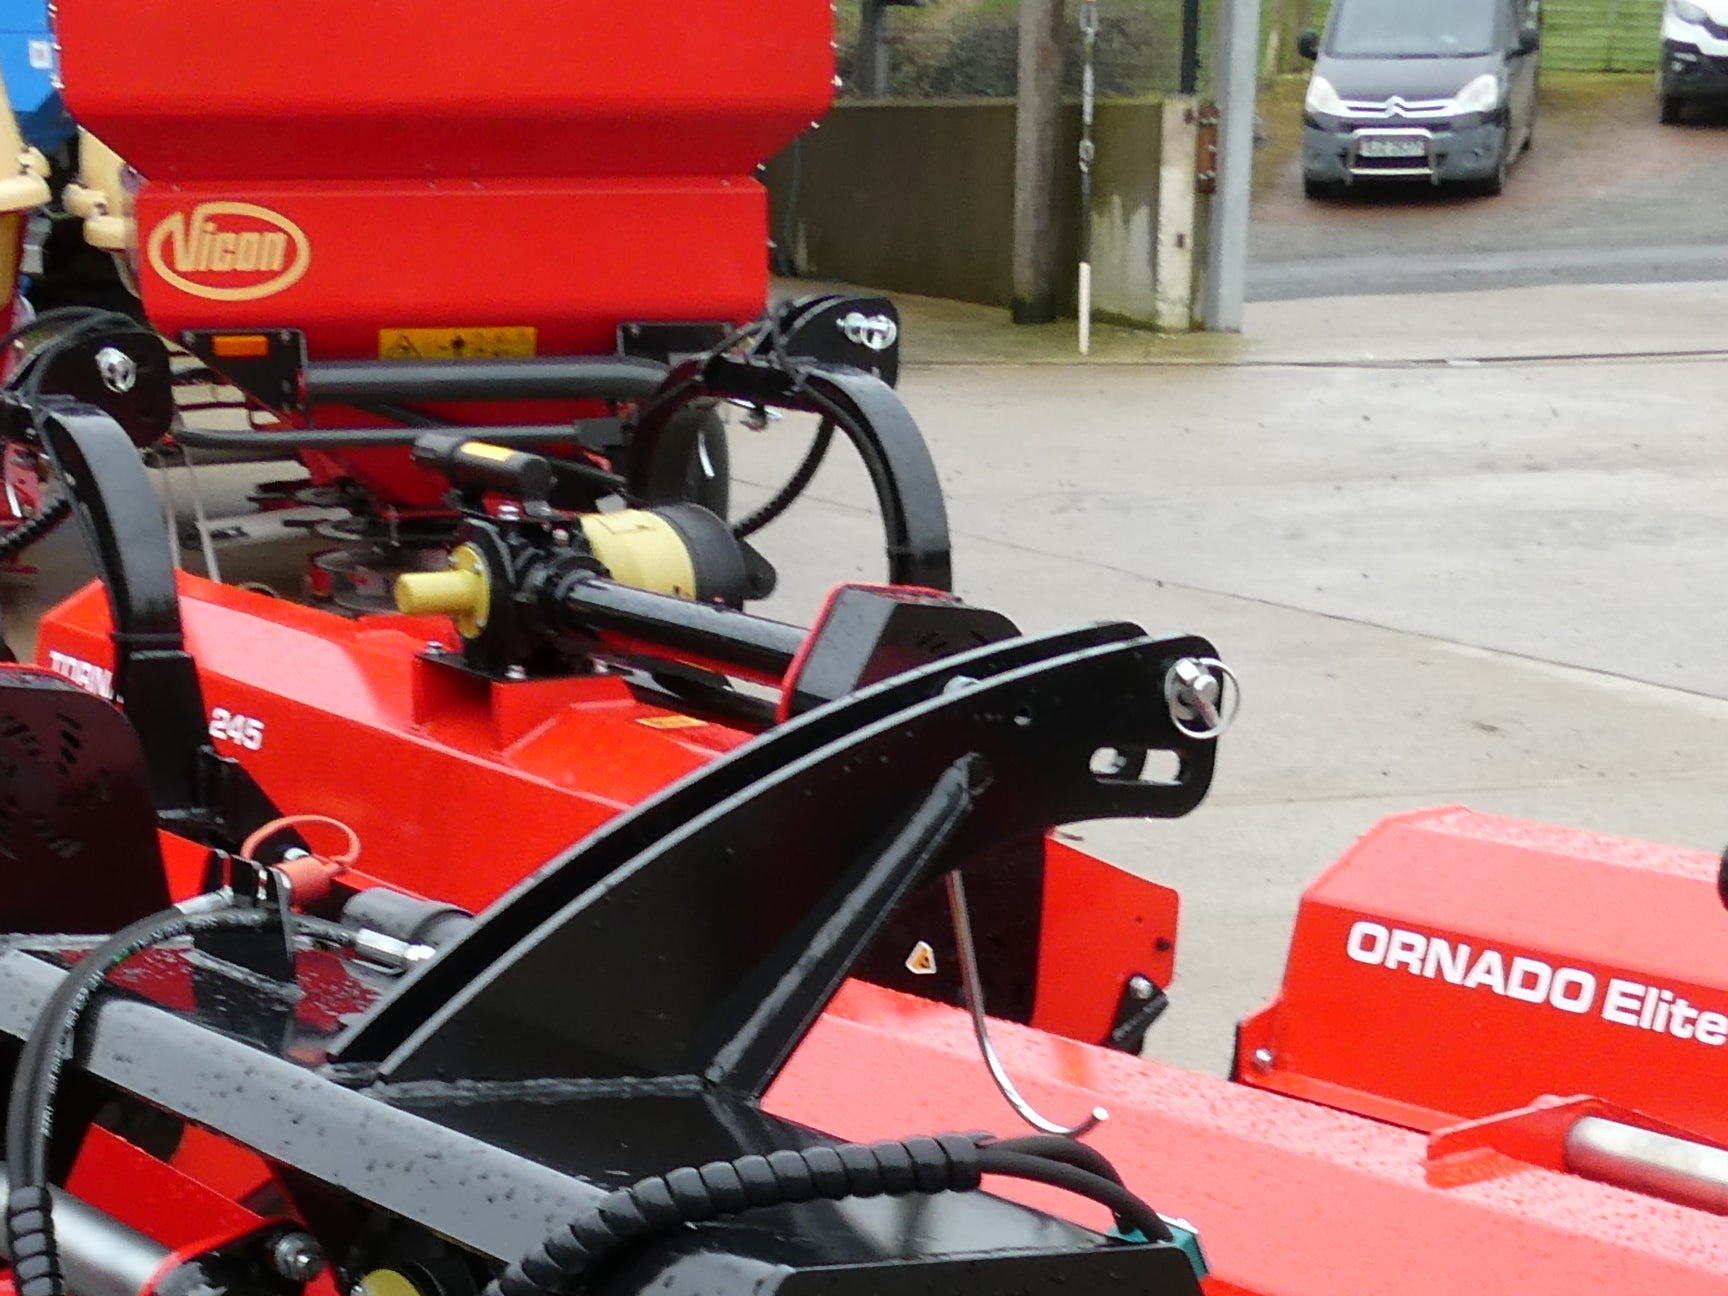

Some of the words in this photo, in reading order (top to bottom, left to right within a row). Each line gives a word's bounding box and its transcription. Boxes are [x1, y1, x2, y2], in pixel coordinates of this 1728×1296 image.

[162, 205, 291, 274] Vicon
[208, 707, 265, 751] 245
[1346, 920, 1597, 1015] ORNADO
